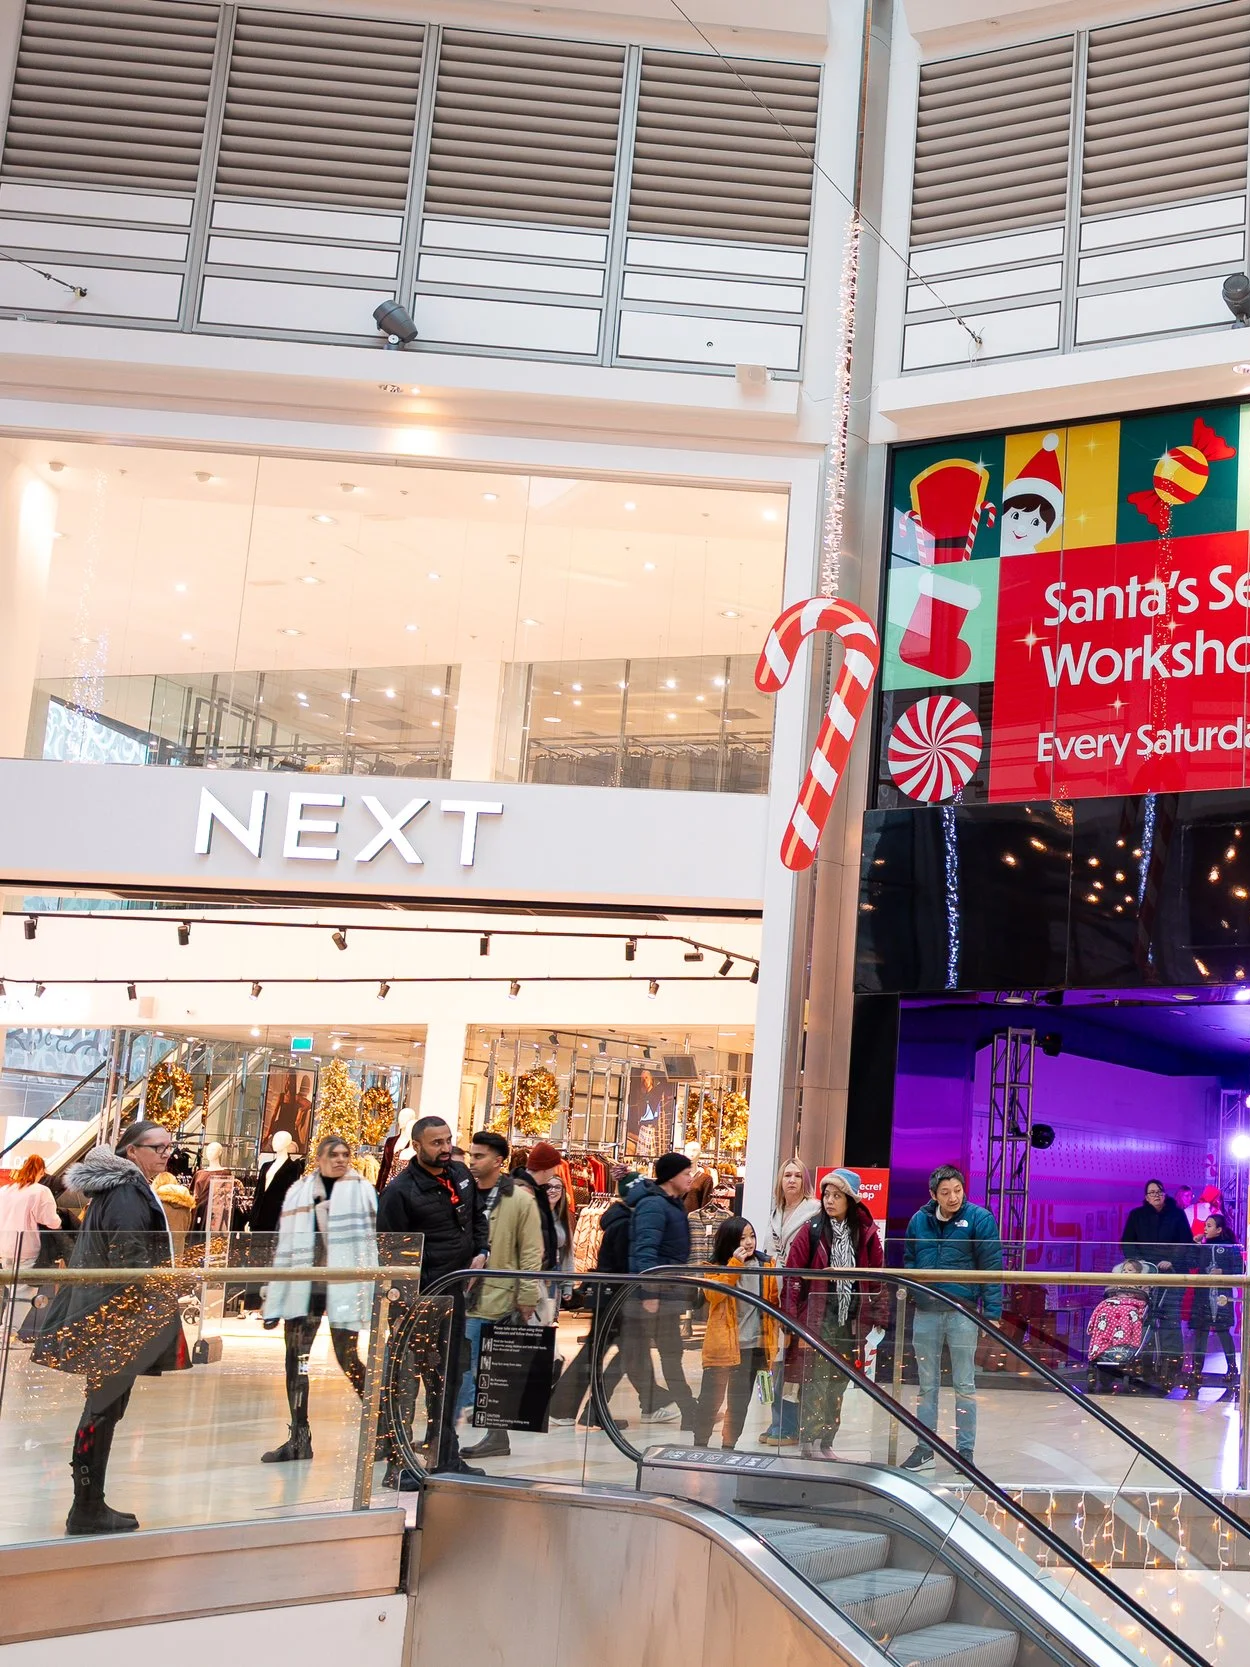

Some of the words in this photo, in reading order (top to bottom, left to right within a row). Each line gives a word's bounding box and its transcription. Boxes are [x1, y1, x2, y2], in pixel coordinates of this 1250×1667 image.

[1042, 568, 1198, 627] Santa's
[1037, 731, 1132, 766] Every
[194, 787, 504, 867] NEXT
[859, 1183, 882, 1191] ecret
